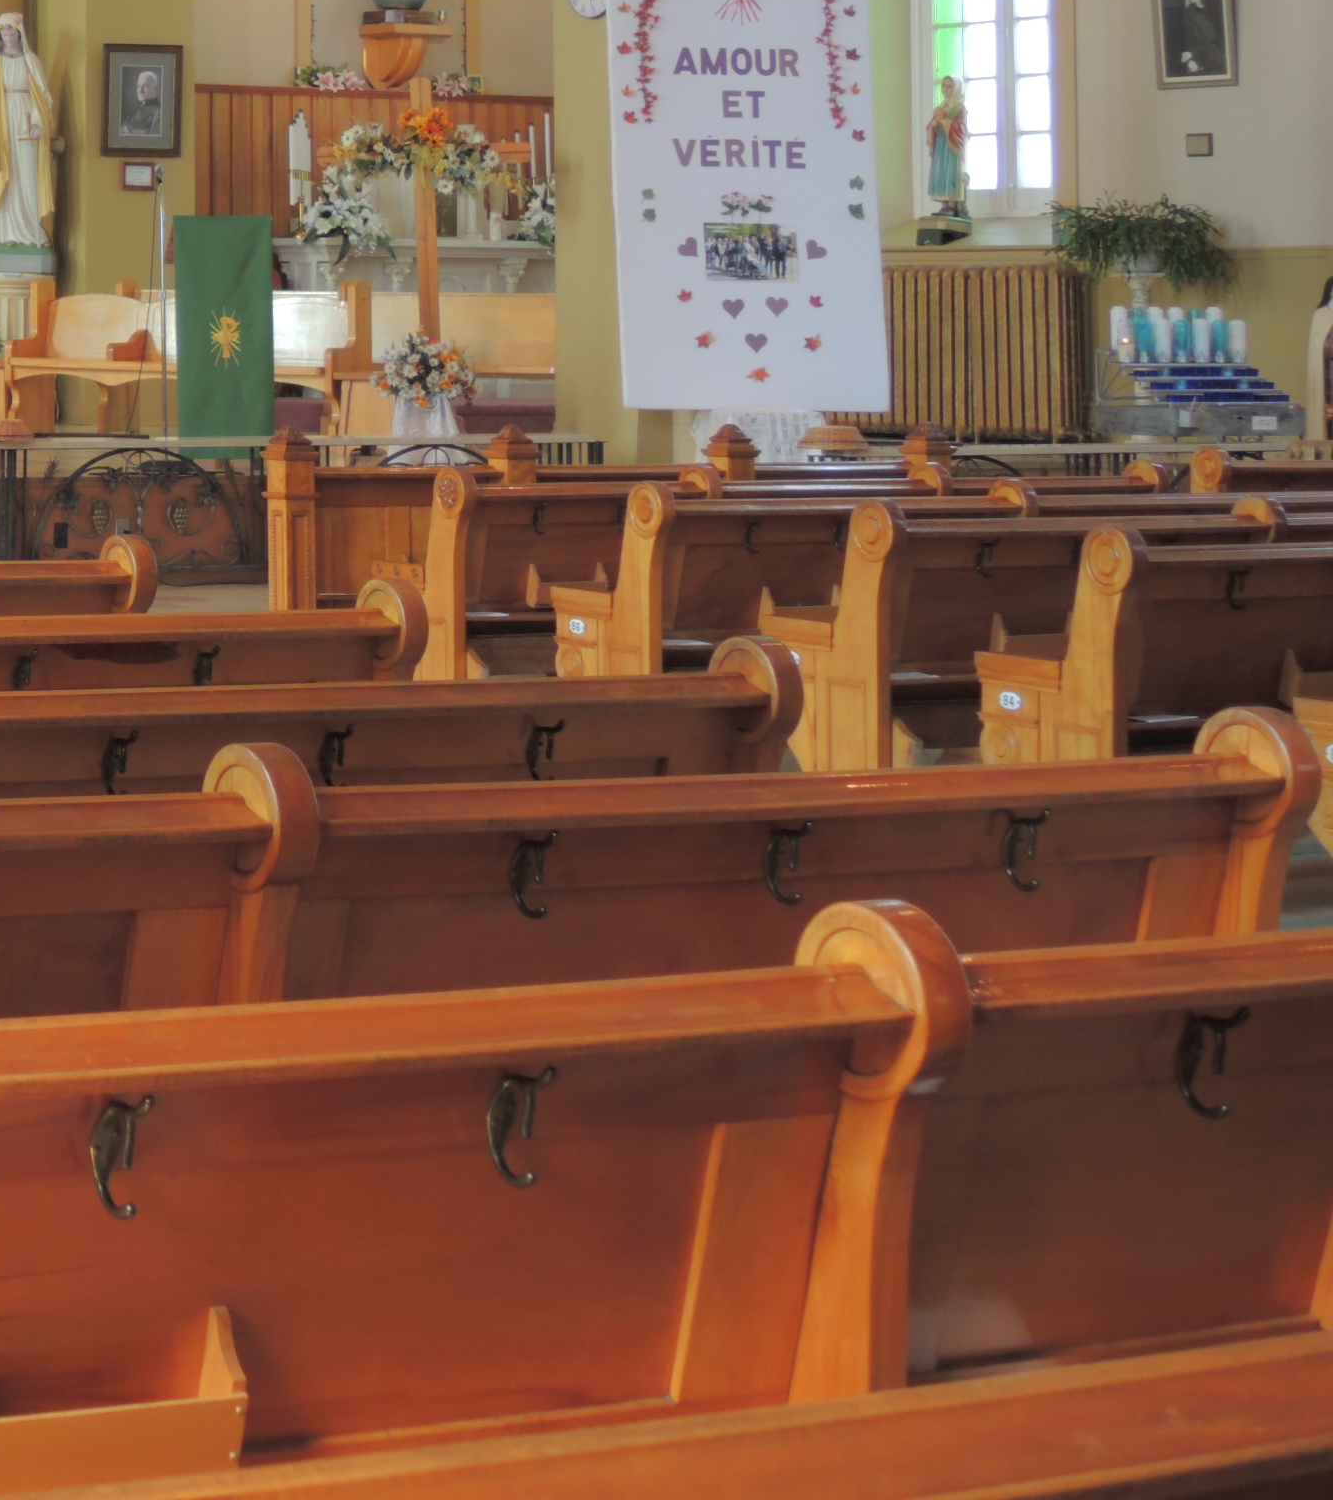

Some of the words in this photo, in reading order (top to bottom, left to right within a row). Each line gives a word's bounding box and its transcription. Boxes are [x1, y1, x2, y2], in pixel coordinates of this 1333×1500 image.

[673, 47, 800, 77] AMOUR
[721, 90, 766, 119] ET
[1003, 694, 1015, 706] 84
